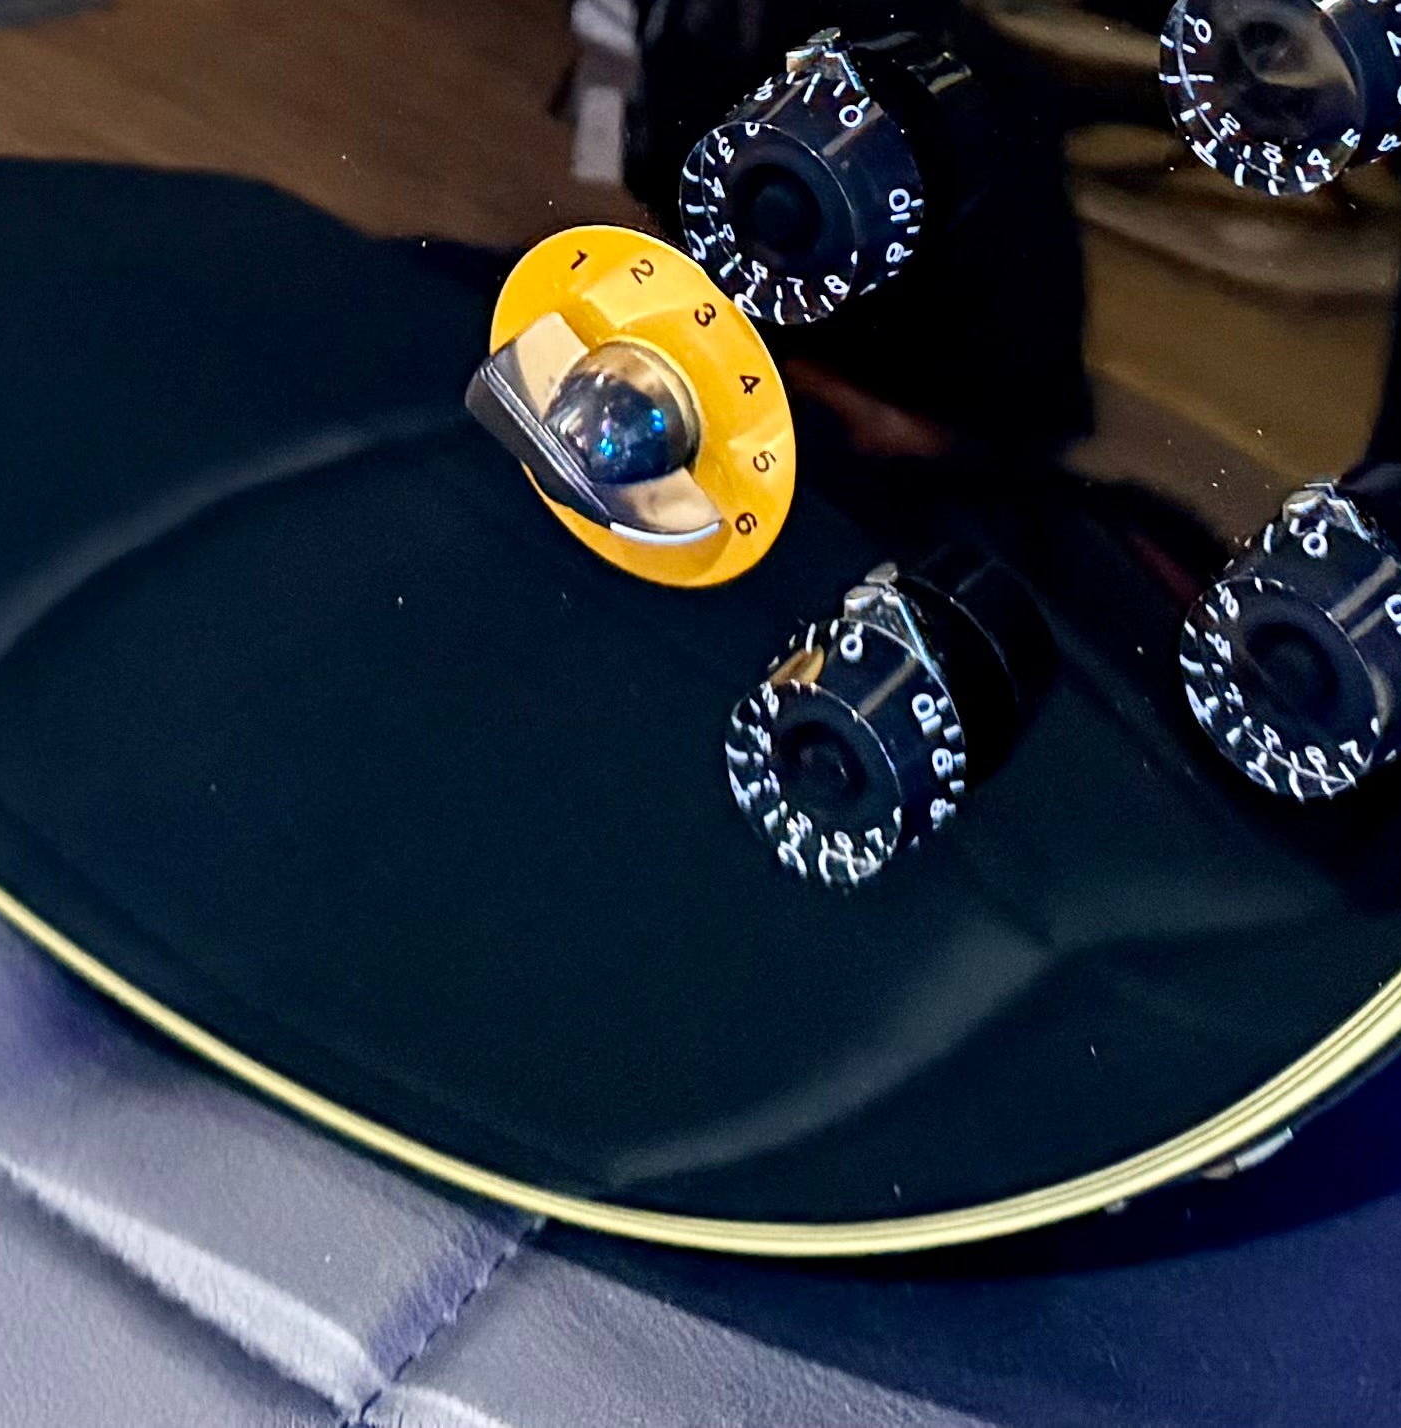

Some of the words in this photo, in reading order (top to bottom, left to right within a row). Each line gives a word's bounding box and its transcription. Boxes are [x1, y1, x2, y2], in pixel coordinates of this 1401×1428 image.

[569, 248, 589, 272] 1
[628, 258, 656, 285] 2
[693, 301, 718, 329] 3
[738, 372, 762, 396] 4
[752, 449, 778, 474] 5
[734, 510, 759, 536] 6
